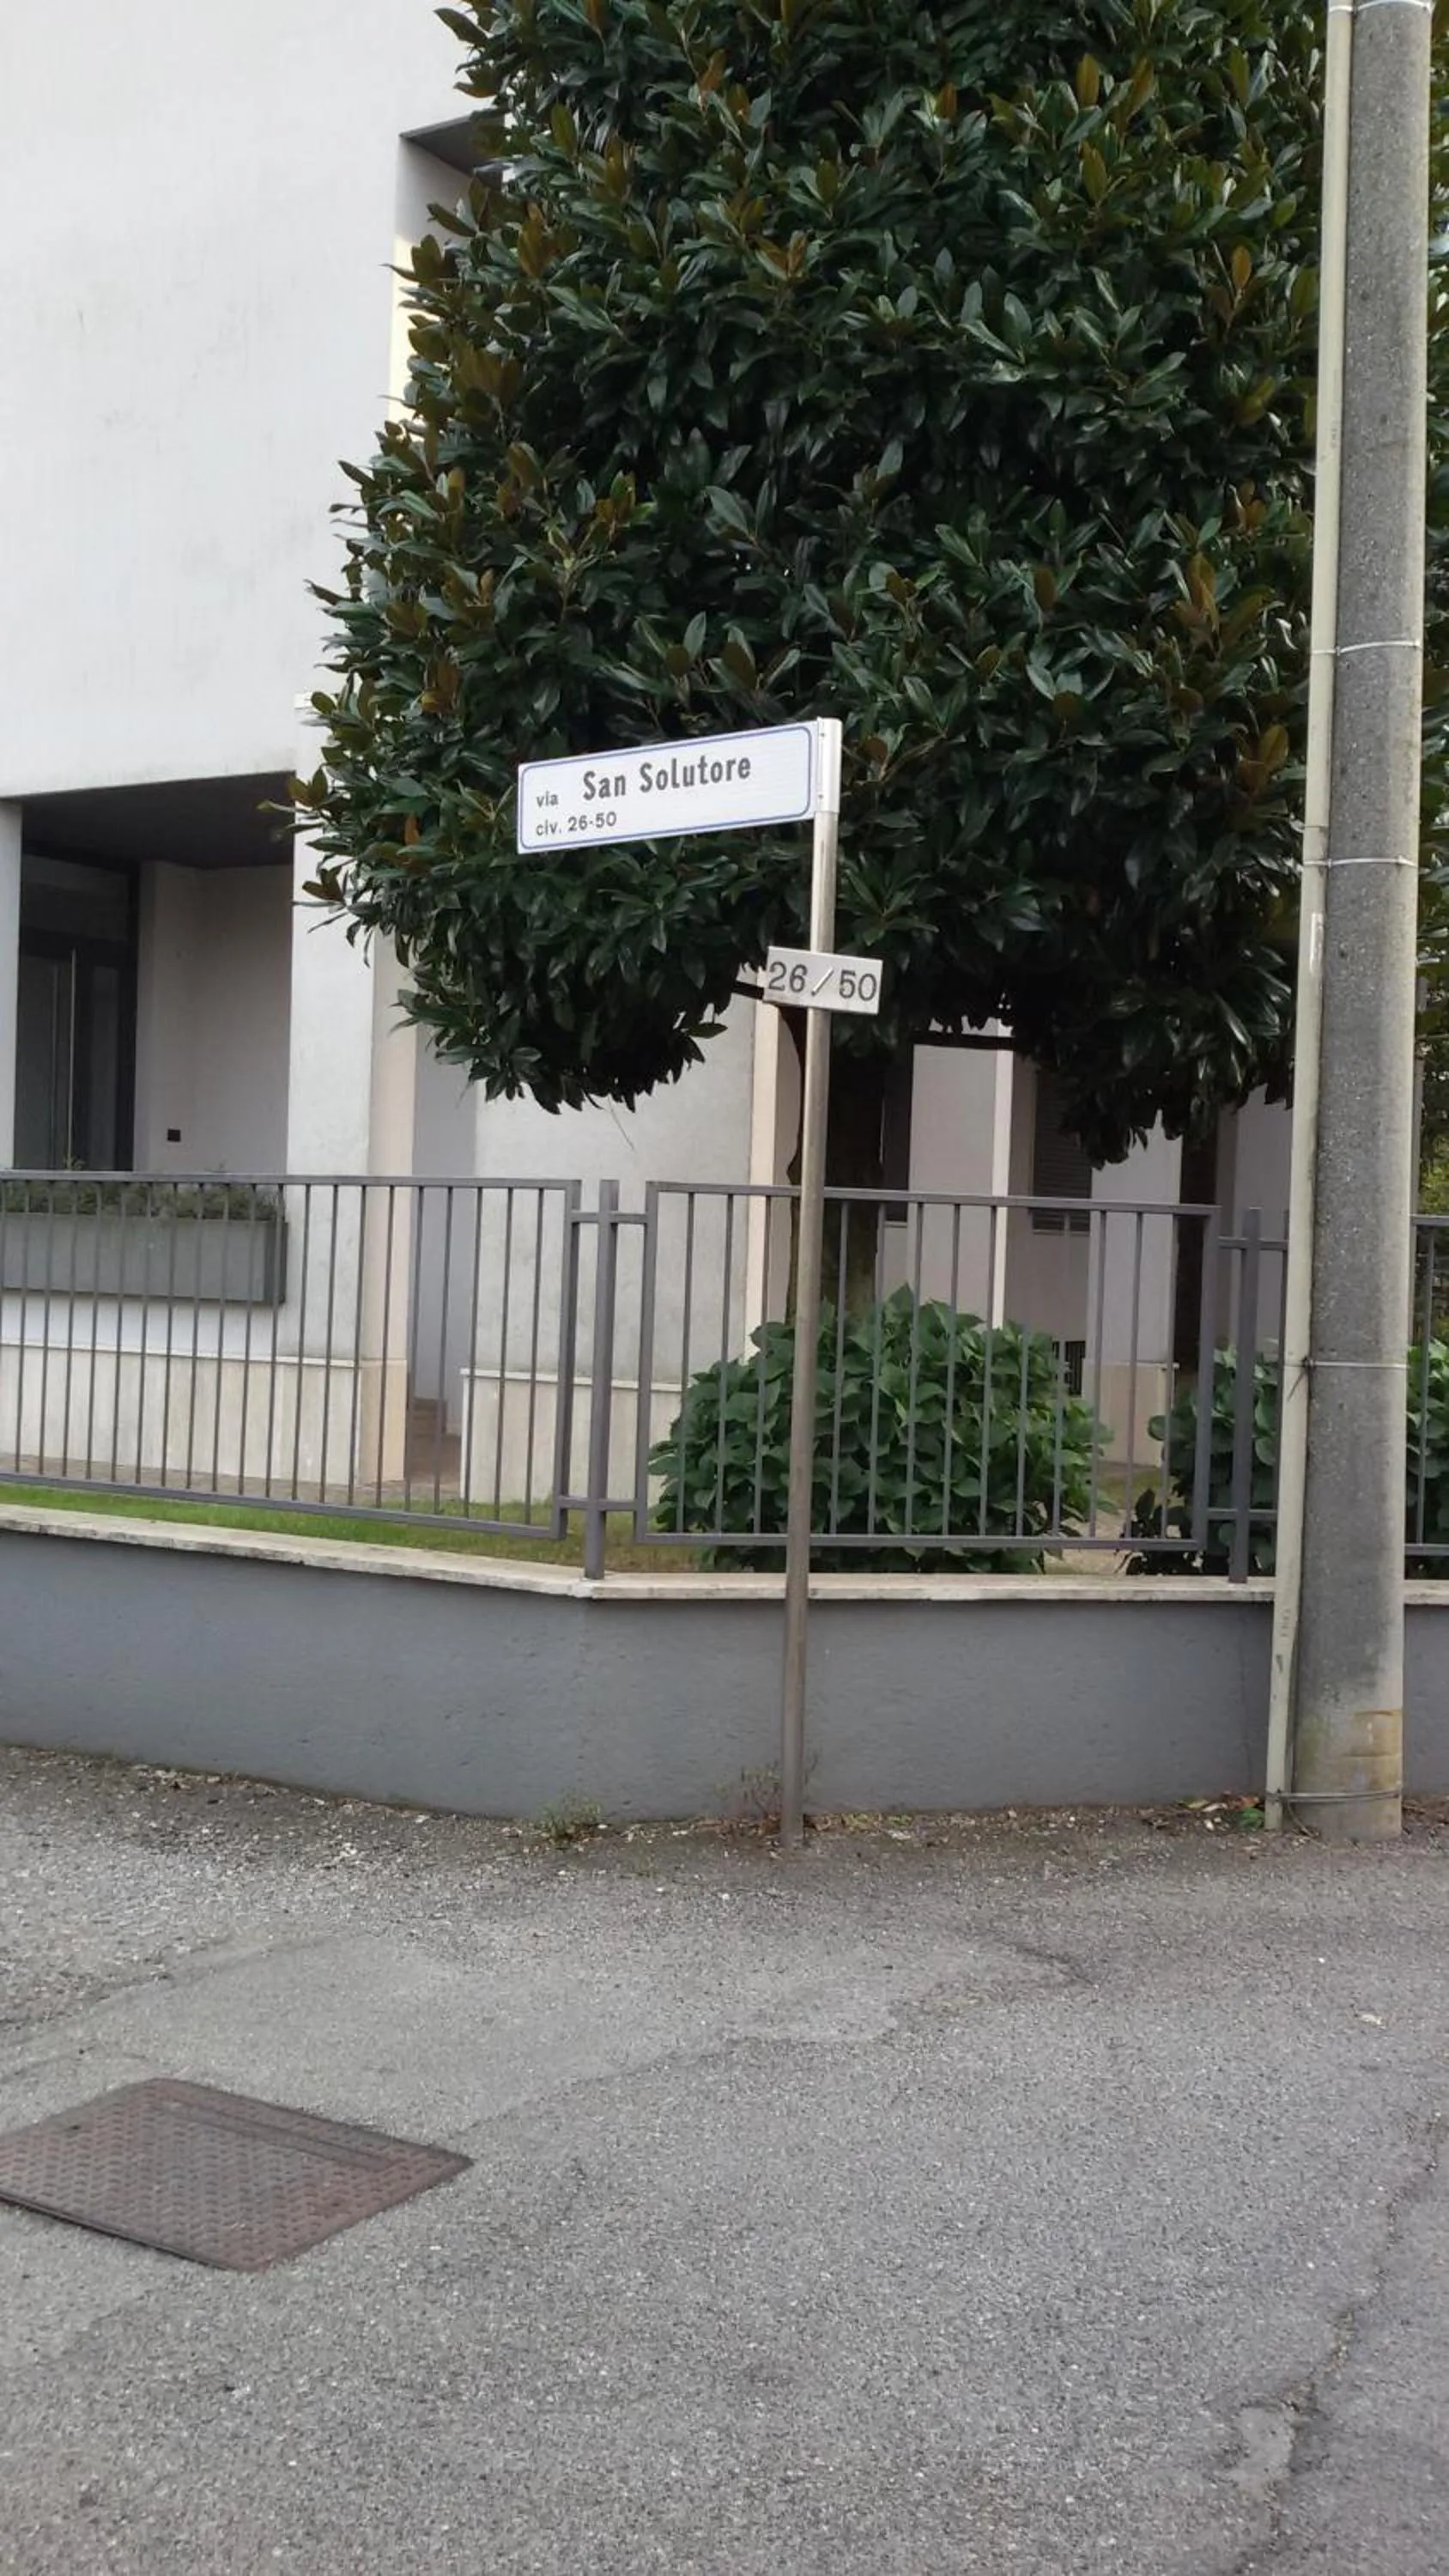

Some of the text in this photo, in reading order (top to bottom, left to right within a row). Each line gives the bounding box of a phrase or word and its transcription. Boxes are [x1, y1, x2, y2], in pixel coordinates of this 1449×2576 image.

[536, 756, 751, 808] via San Solutore
[536, 811, 617, 835] civ. 26-50
[767, 962, 877, 1001] 26/50
